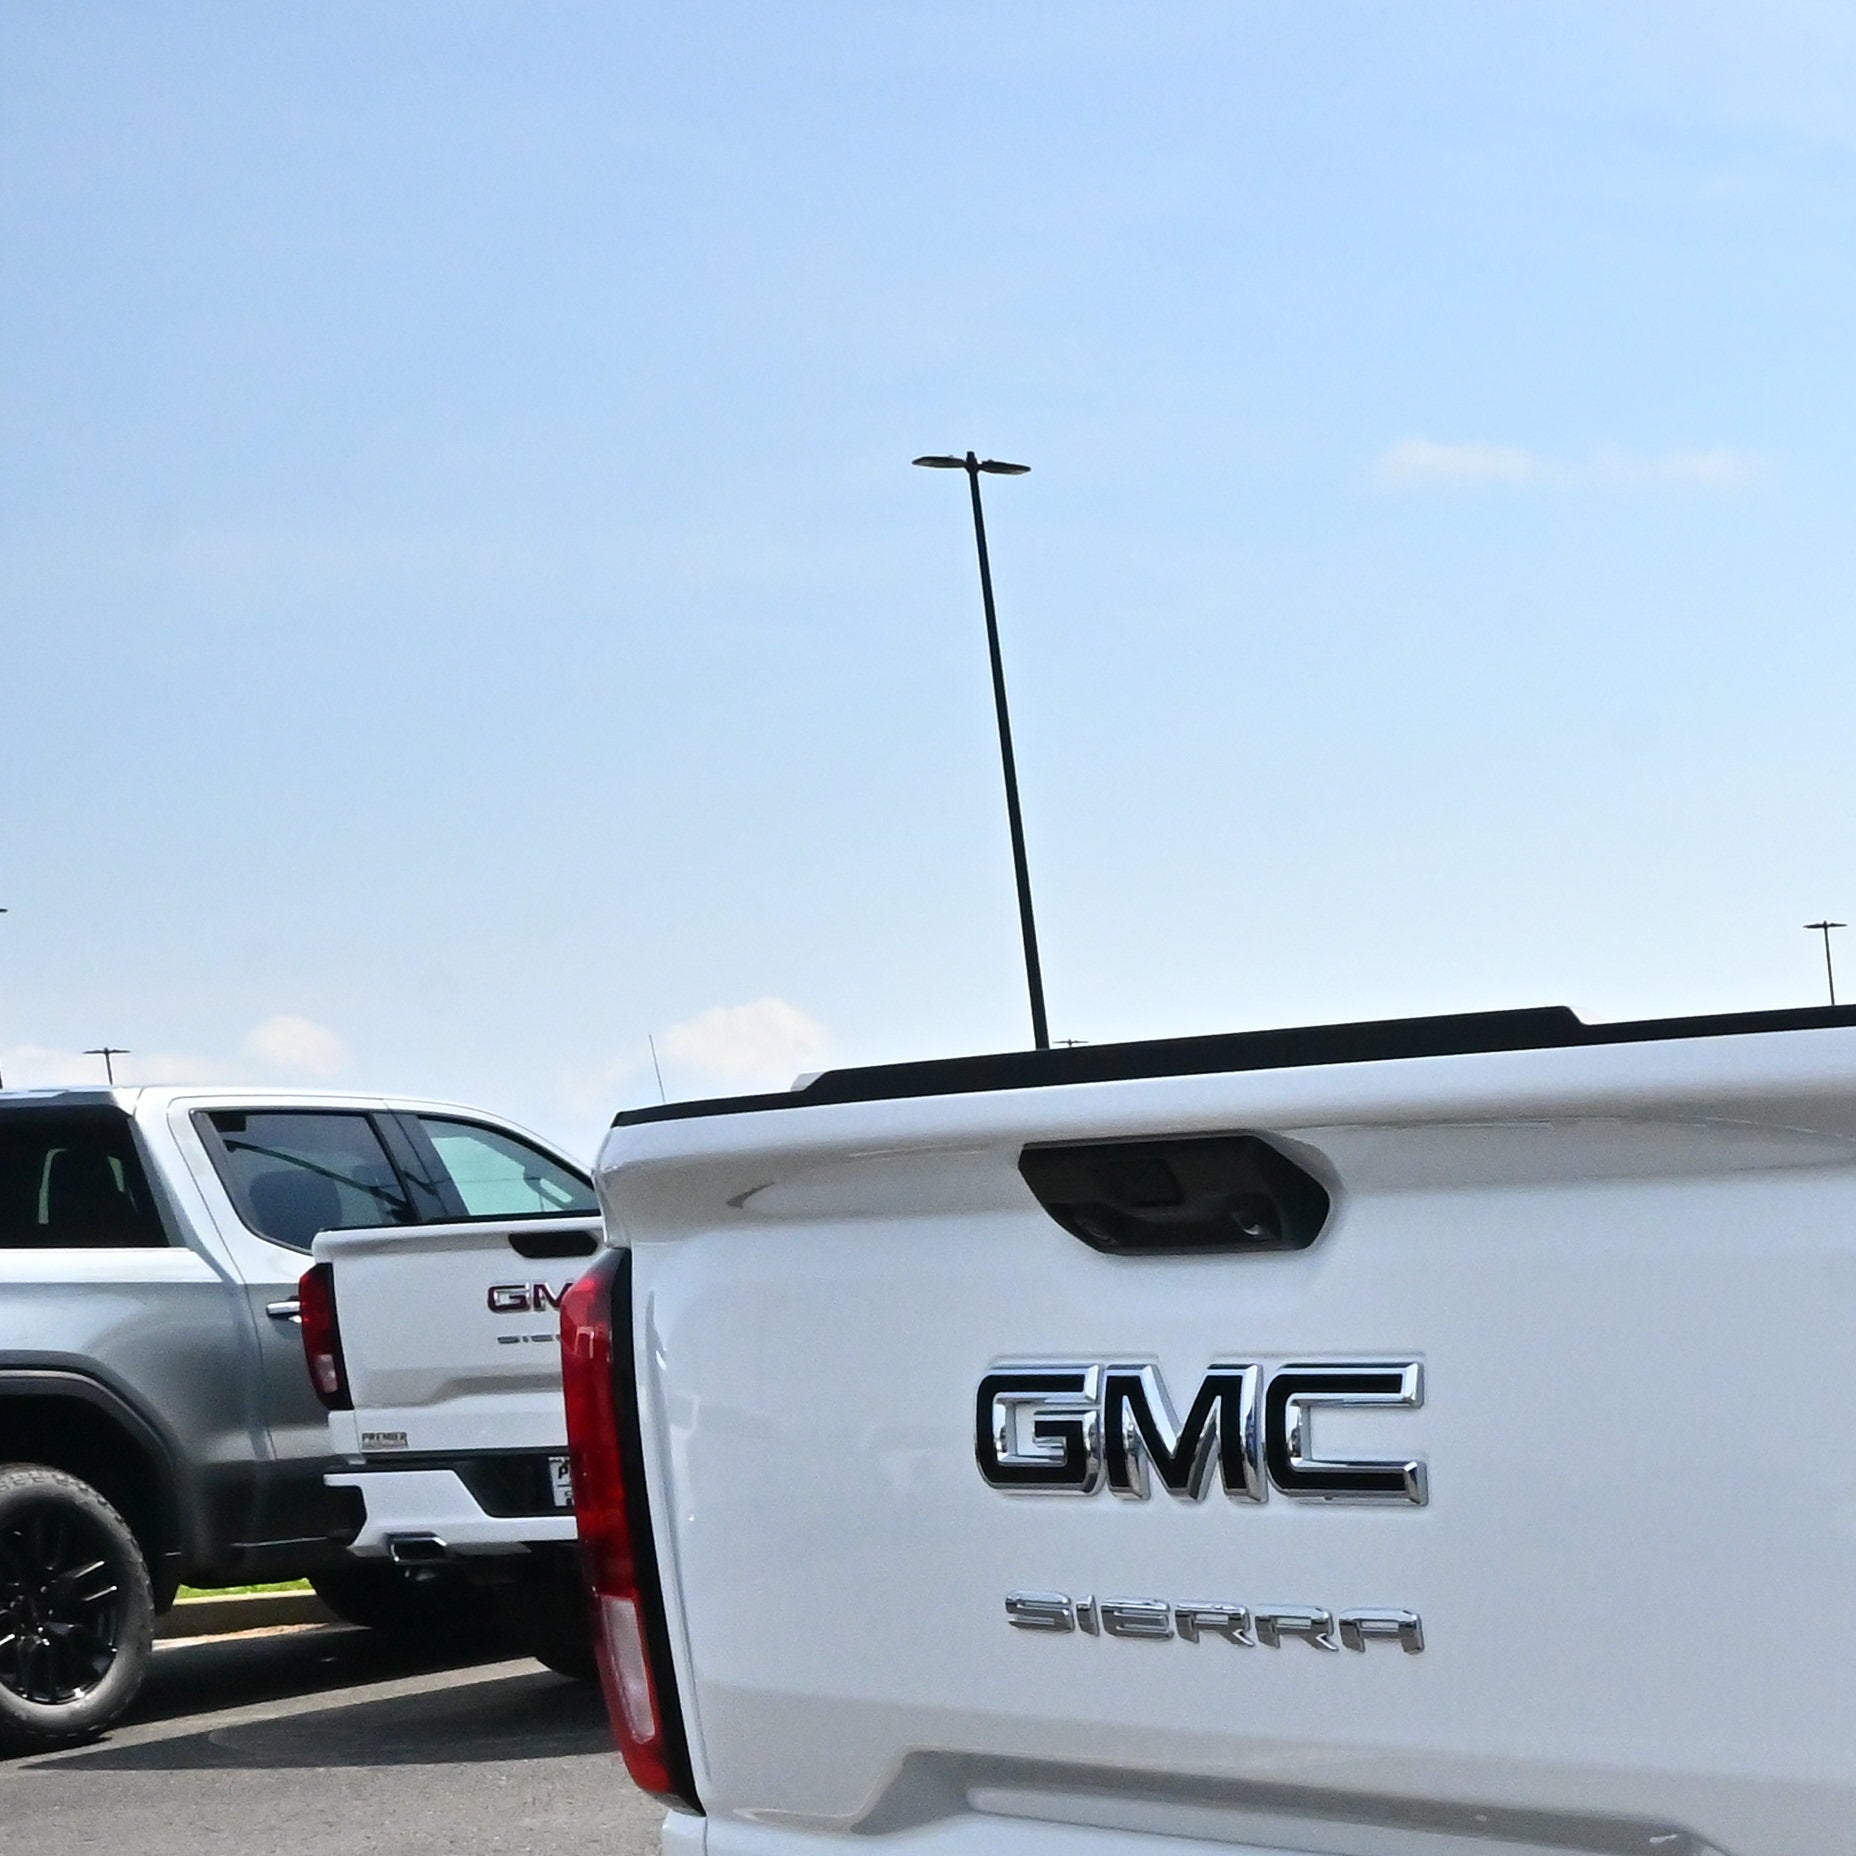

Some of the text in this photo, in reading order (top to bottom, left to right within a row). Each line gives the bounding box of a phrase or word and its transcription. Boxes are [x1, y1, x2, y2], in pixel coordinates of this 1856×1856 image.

[487, 1282, 575, 1314] GM
[975, 1361, 1430, 1507] GMC
[1004, 1588, 1425, 1655] SIERRA
